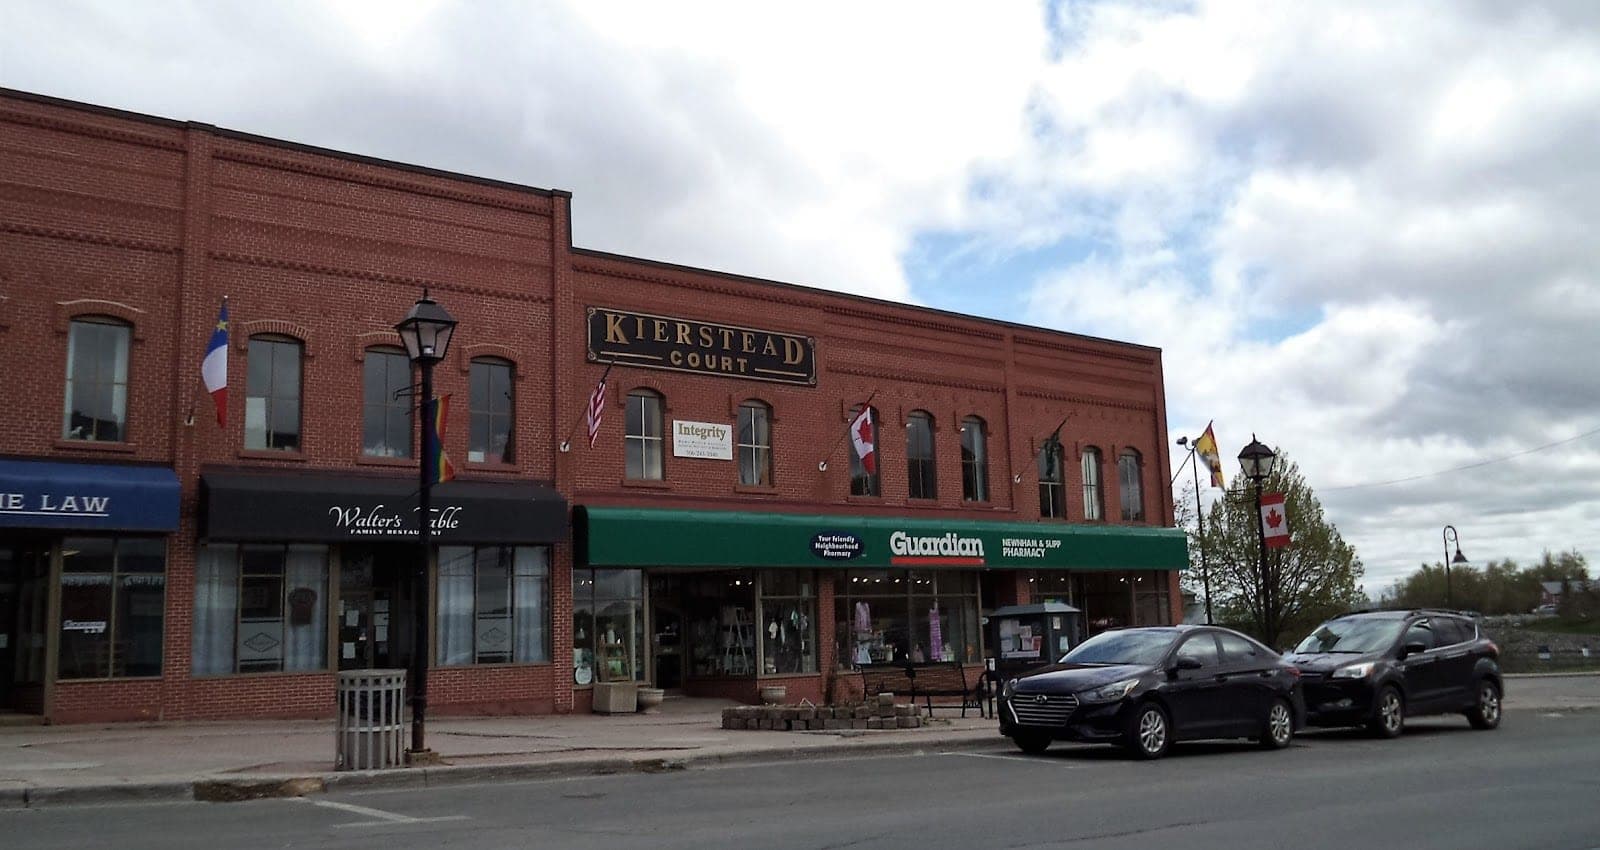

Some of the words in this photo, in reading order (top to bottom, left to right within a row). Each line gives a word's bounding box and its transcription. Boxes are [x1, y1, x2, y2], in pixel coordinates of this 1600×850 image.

[603, 312, 805, 366] KIERSTEAD
[669, 350, 748, 373] COURT
[678, 423, 726, 441] Integrity
[40, 494, 110, 512] LAW
[328, 504, 402, 528] Walter's
[889, 531, 985, 557] Guardian
[1002, 538, 1037, 547] NEWNHAM
[1038, 539, 1044, 547] &
[1045, 540, 1061, 548] SUPP
[1002, 547, 1046, 557] PHARMACY
[823, 550, 851, 558] Pharmacy
